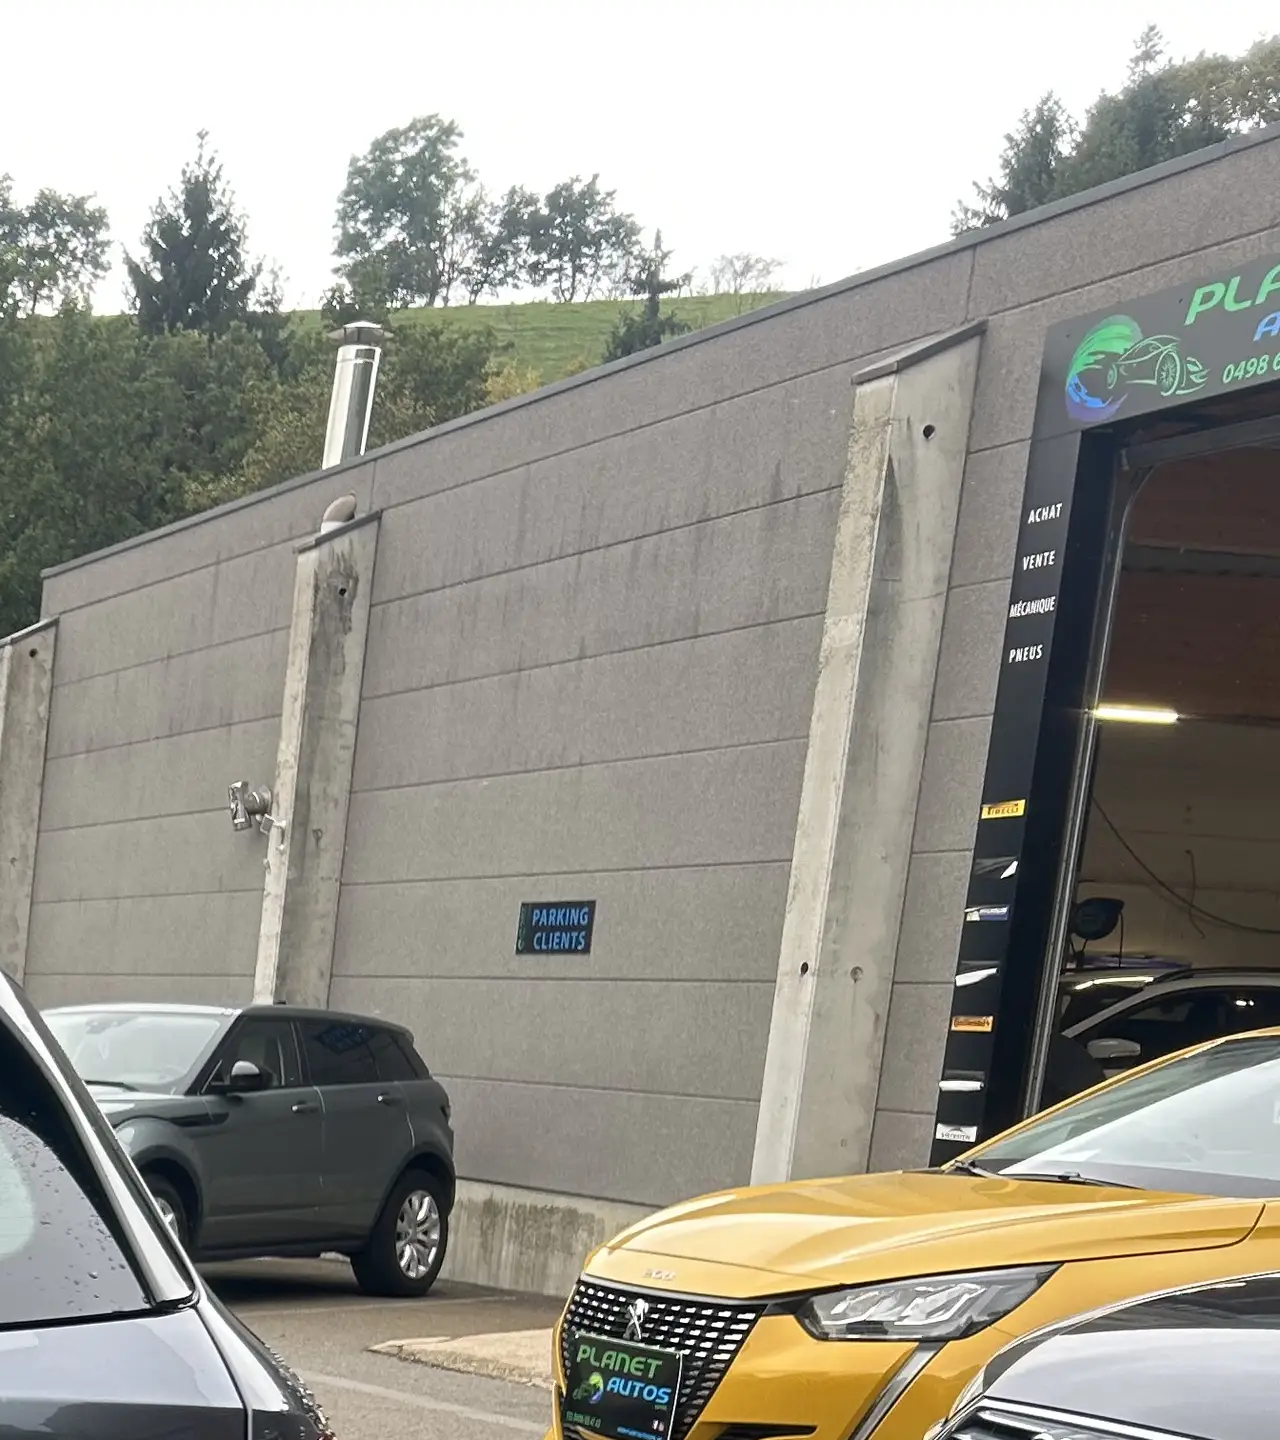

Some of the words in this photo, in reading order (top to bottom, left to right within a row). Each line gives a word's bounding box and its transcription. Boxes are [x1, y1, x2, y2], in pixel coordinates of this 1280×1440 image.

[1222, 354, 1269, 383] 0498
[1027, 503, 1063, 524] ACHAT
[1022, 550, 1056, 571] VENTE
[1009, 596, 1056, 618] MÉCANIQUE
[1008, 644, 1043, 664] PNEUS
[532, 907, 589, 927] PARKING
[533, 931, 585, 951] CLIENTS
[576, 1344, 663, 1379] PLANET
[606, 1377, 672, 1404] AUTOS
